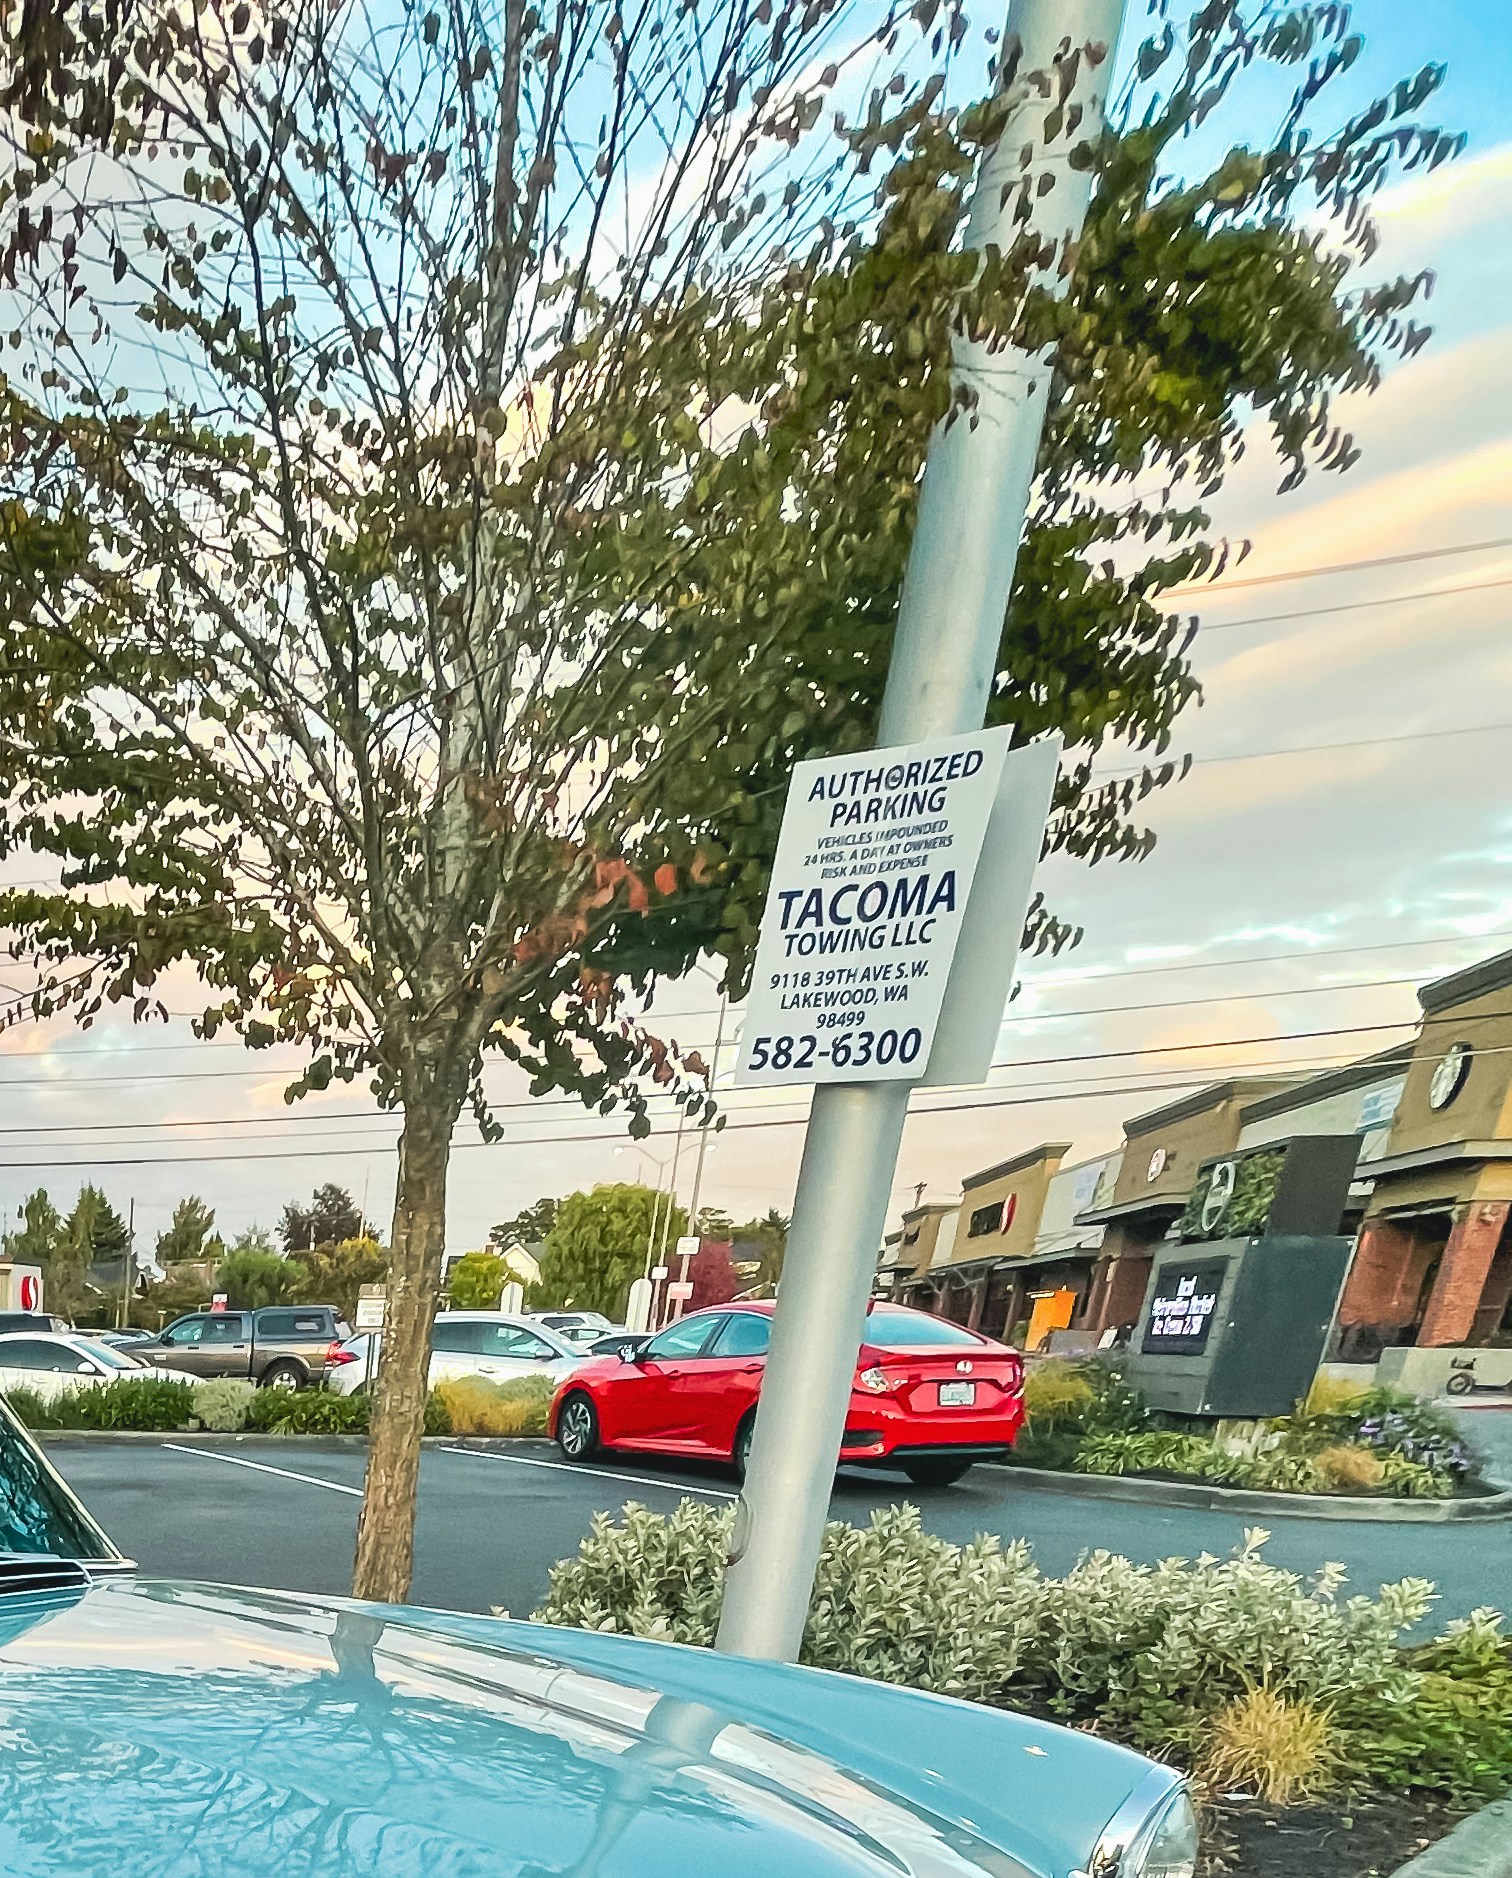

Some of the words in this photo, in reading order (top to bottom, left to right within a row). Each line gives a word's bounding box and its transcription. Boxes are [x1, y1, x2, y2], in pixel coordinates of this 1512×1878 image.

[807, 750, 984, 803] AUTHORIZED
[830, 786, 948, 828] PARKING
[817, 831, 873, 849] VEHICLES
[875, 820, 949, 842] IMPOUNDED
[803, 855, 818, 867] 24
[849, 849, 858, 861] A
[860, 845, 886, 859] DAY
[886, 843, 902, 857] AT
[821, 865, 846, 879] RISK
[849, 863, 876, 877] AND
[878, 855, 929, 873] EXPENSE
[777, 870, 956, 931] TACOMA
[784, 924, 888, 958] TOWING
[890, 918, 937, 947] LLC
[769, 971, 812, 989] 9118
[814, 968, 859, 987] 39TH
[859, 962, 893, 983] AVE
[894, 959, 929, 980] S.W.
[780, 987, 880, 1010] LAKEWOOD,
[883, 984, 909, 1002] WA
[816, 1010, 866, 1029] 98499
[748, 1027, 922, 1071] 582-6300
